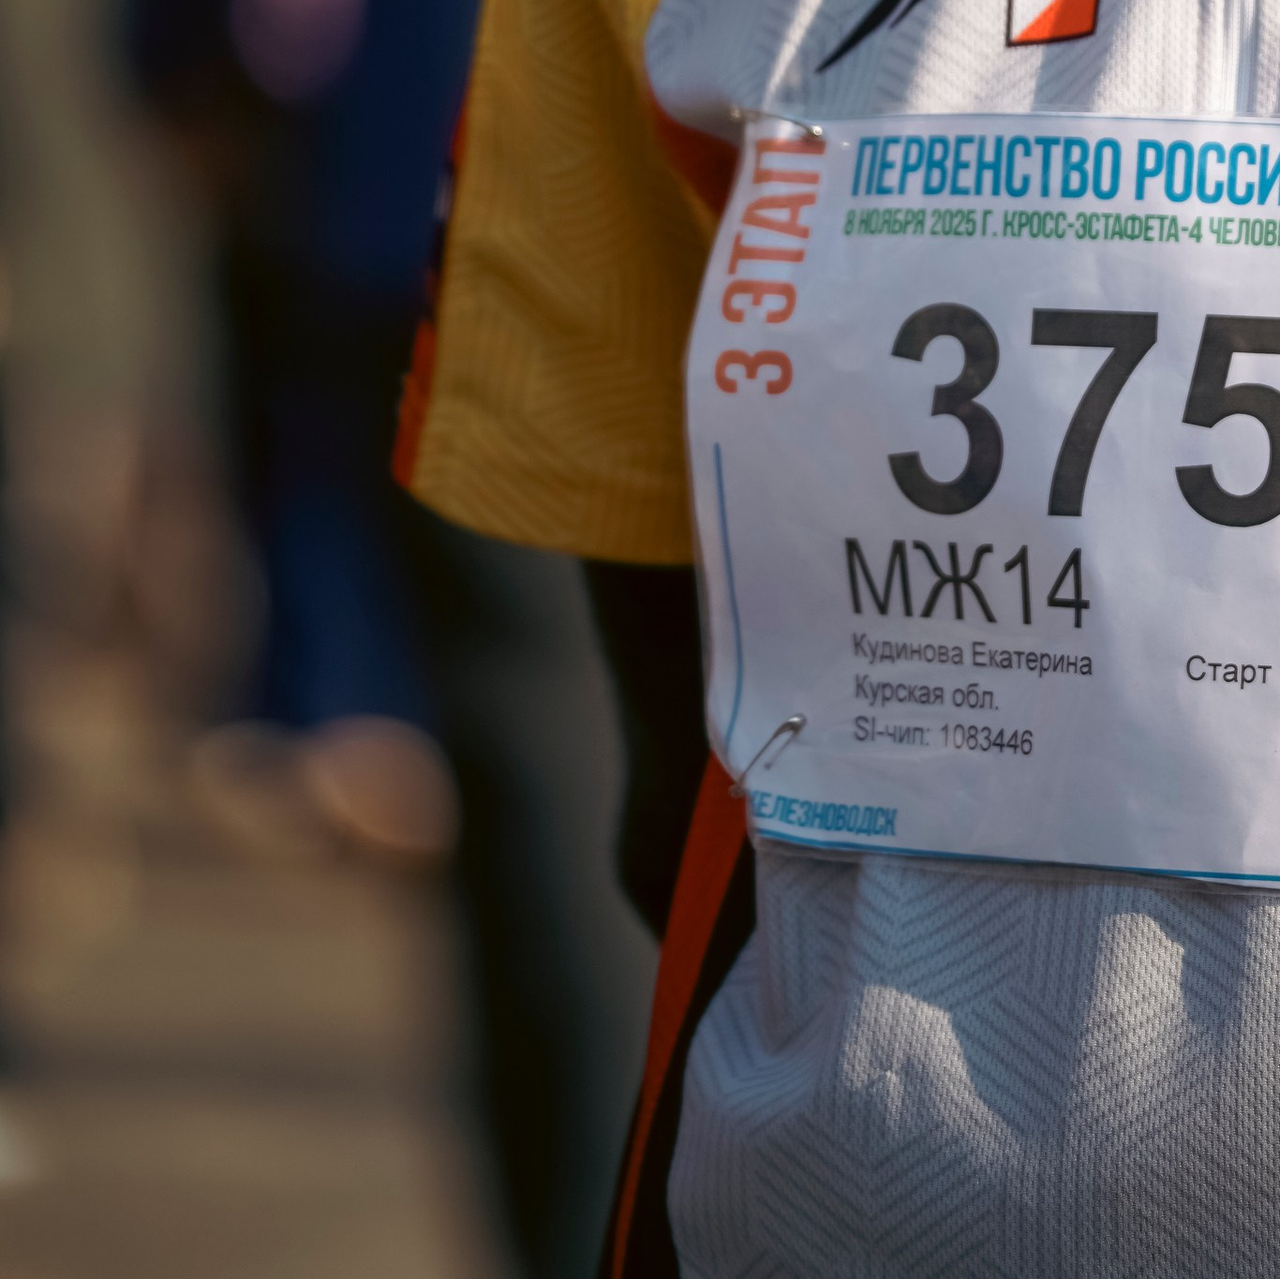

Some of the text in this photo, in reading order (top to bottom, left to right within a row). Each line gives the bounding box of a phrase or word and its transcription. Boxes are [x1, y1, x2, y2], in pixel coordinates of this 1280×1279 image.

[852, 134, 1122, 201] ПЕРВЕНСТВО
[844, 208, 857, 237] 8
[857, 207, 927, 237] НОЯБРЯ
[929, 208, 977, 238] 2025
[981, 209, 998, 238] Г.
[714, 137, 827, 396] 3 ЭТАП
[844, 537, 1091, 629] МЖ14
[852, 632, 1093, 678] Кудинова Екатерина
[1185, 654, 1273, 690] Старт
[854, 673, 1000, 711] Курская обл.
[940, 723, 1034, 756] 1083446
